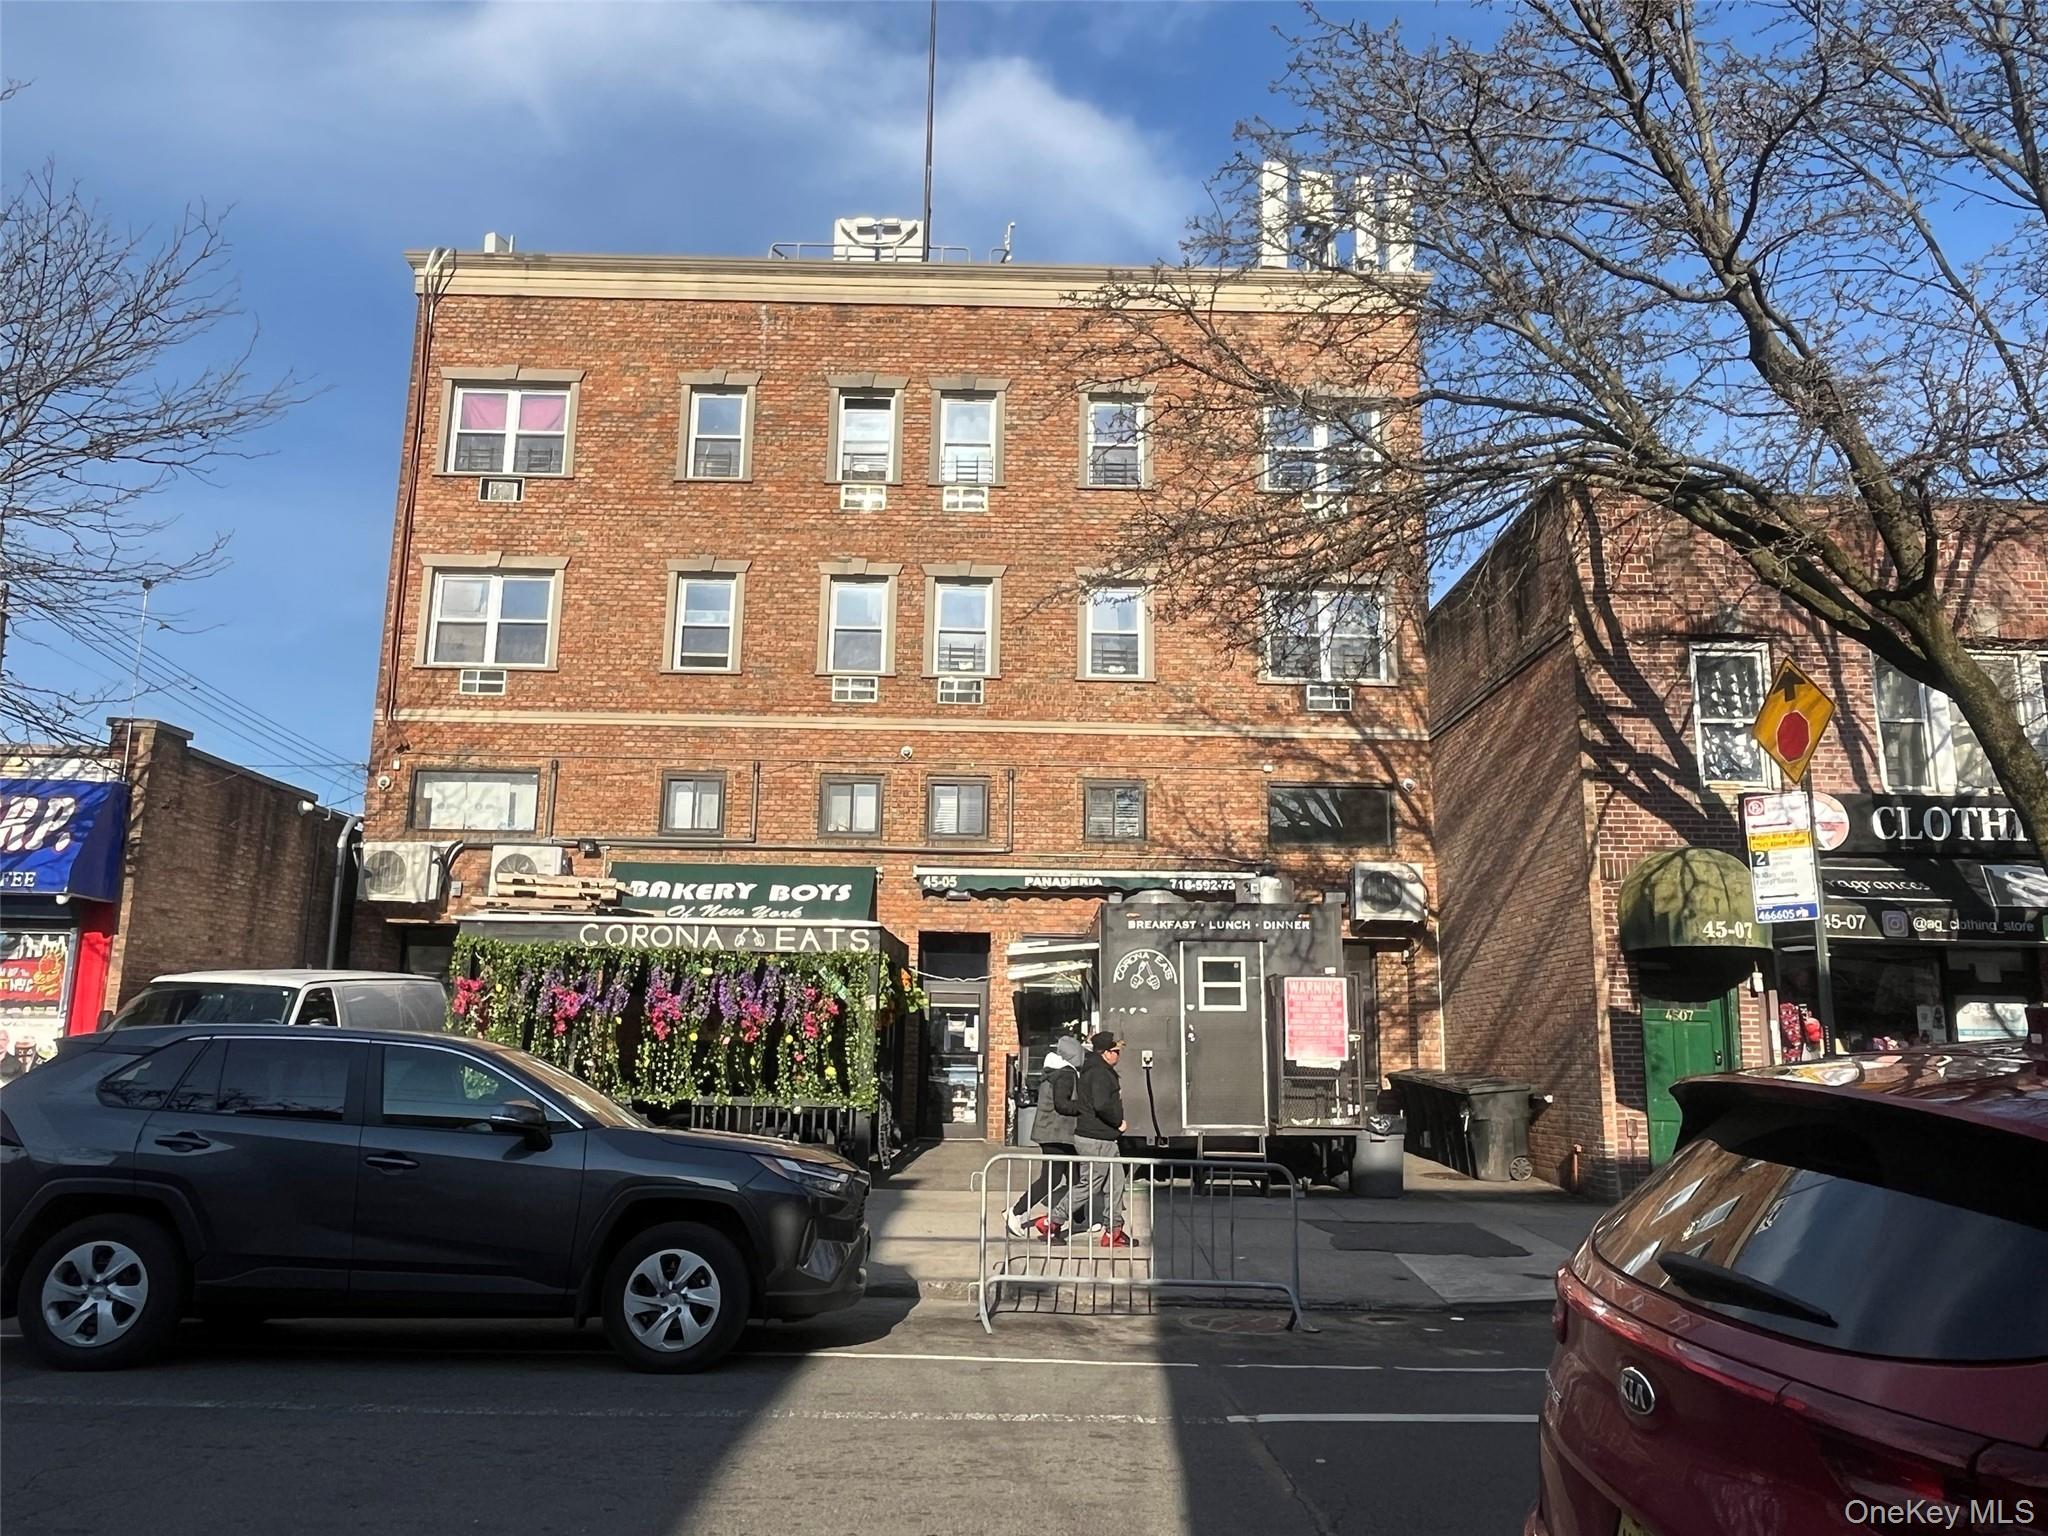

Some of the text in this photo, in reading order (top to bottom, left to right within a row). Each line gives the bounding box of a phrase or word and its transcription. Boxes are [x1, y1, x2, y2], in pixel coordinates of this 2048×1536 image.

[0, 797, 76, 852] RP.
[1755, 851, 1767, 866] 2
[923, 876, 958, 888] 45-05
[1024, 876, 1103, 887] PANADERIA
[630, 880, 852, 901] BAKERY BOYS
[667, 903, 804, 919] Of New York
[1758, 908, 1796, 921] 466605
[1127, 920, 1311, 930] BREAKFAST LUNCH DINNER
[1702, 920, 1753, 939] 45-07
[1912, 915, 2035, 934] @ag_clothing_store
[579, 922, 871, 952] CORONA EATS
[1116, 951, 1174, 981] CORONA EATS
[1288, 980, 1342, 993] WARNING
[1664, 1009, 1695, 1022] 4507
[1621, 1377, 1647, 1410] KIA
